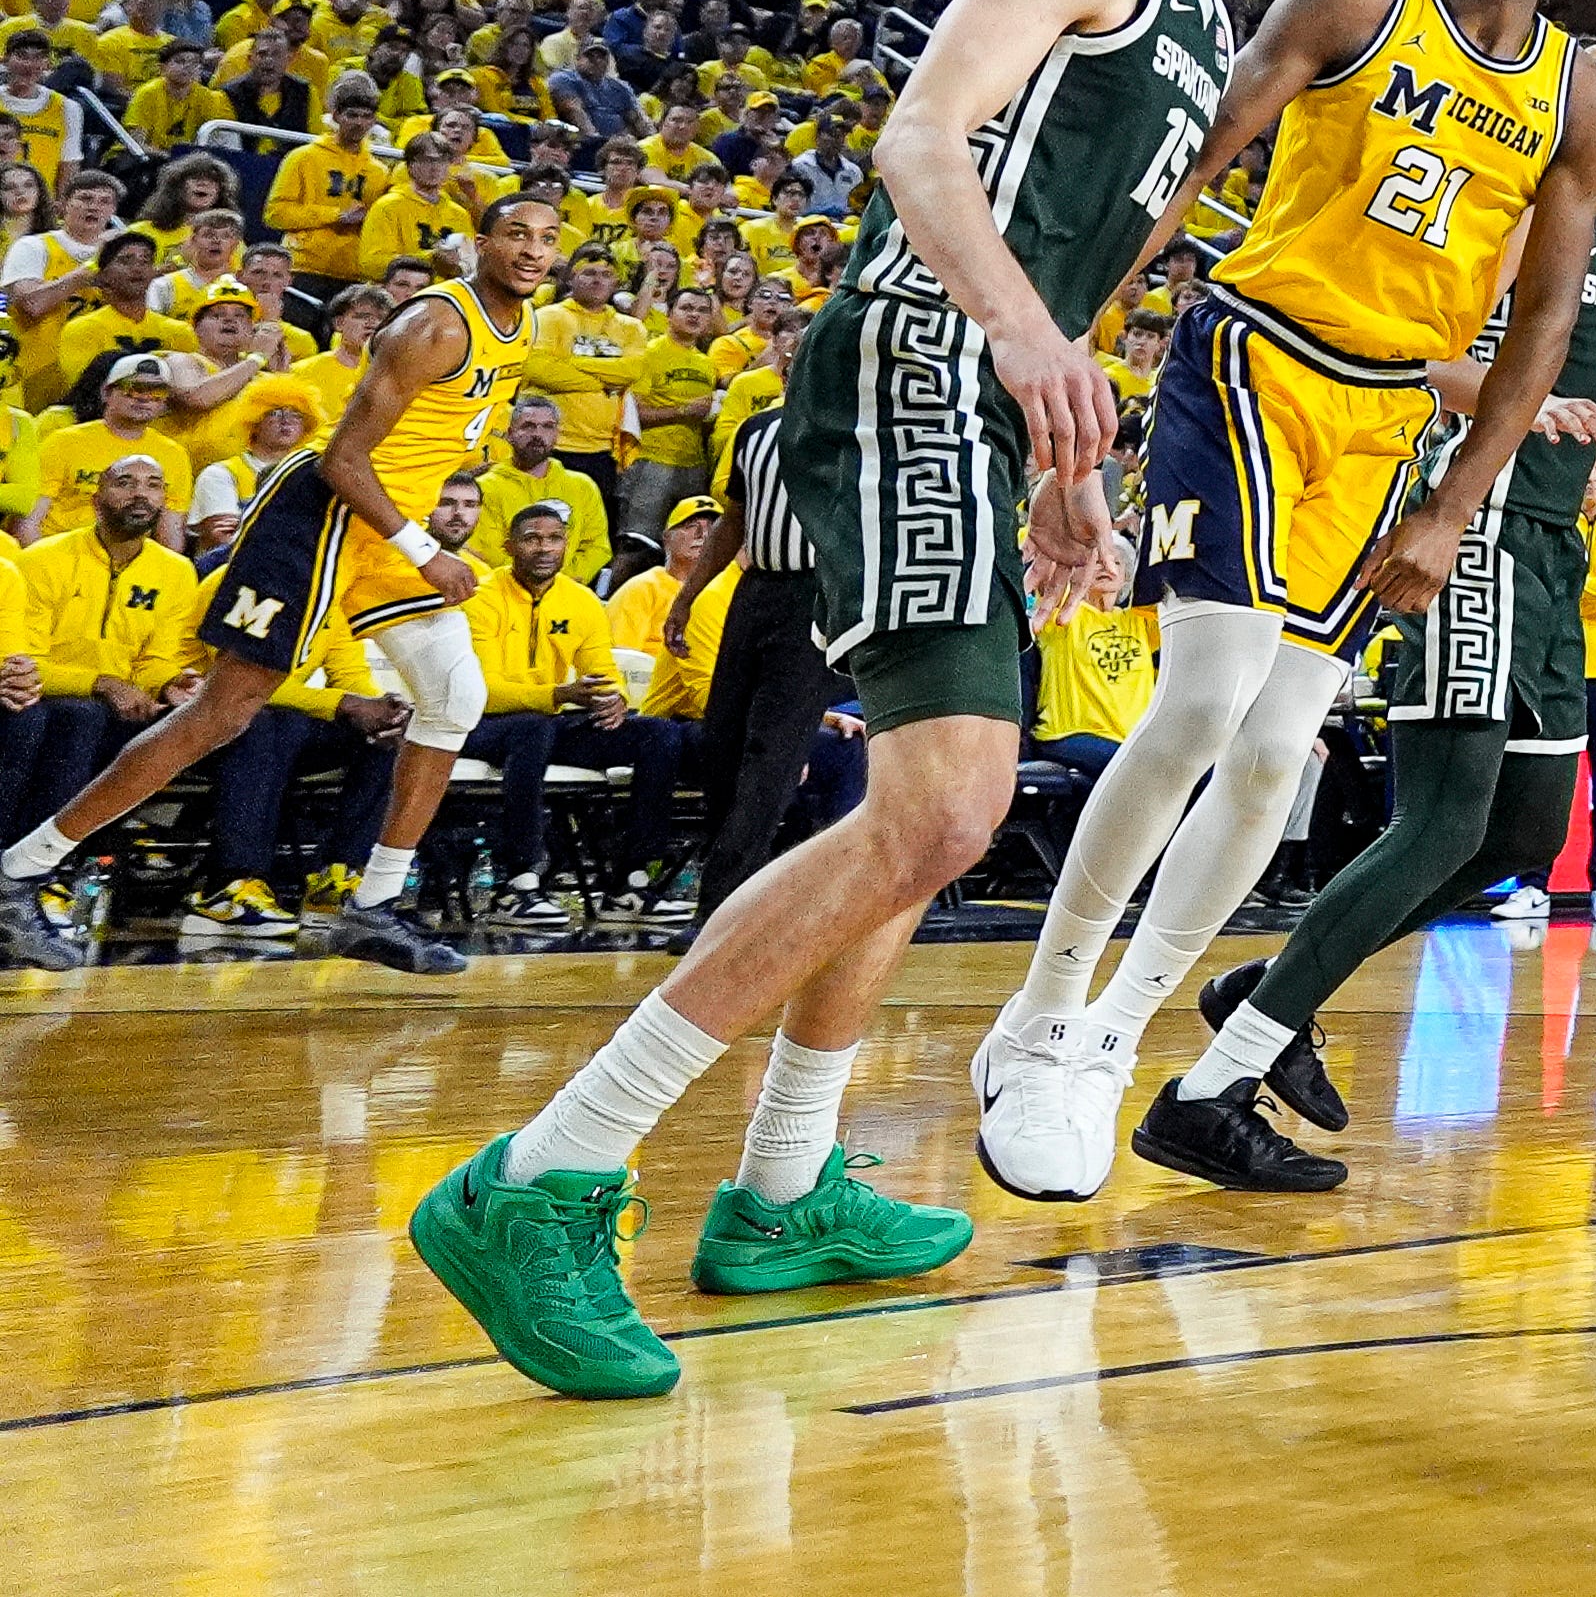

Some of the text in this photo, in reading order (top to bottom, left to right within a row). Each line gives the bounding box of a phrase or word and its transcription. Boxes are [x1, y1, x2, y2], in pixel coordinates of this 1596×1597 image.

[1151, 33, 1222, 128] SPARTAN
[1373, 61, 1544, 159] MICHIGAN
[1130, 106, 1205, 221] 15
[1364, 144, 1475, 250] 21
[463, 403, 494, 452] 4
[1149, 499, 1201, 566] M
[125, 584, 160, 611] M
[223, 584, 286, 640] M
[549, 618, 571, 635] M
